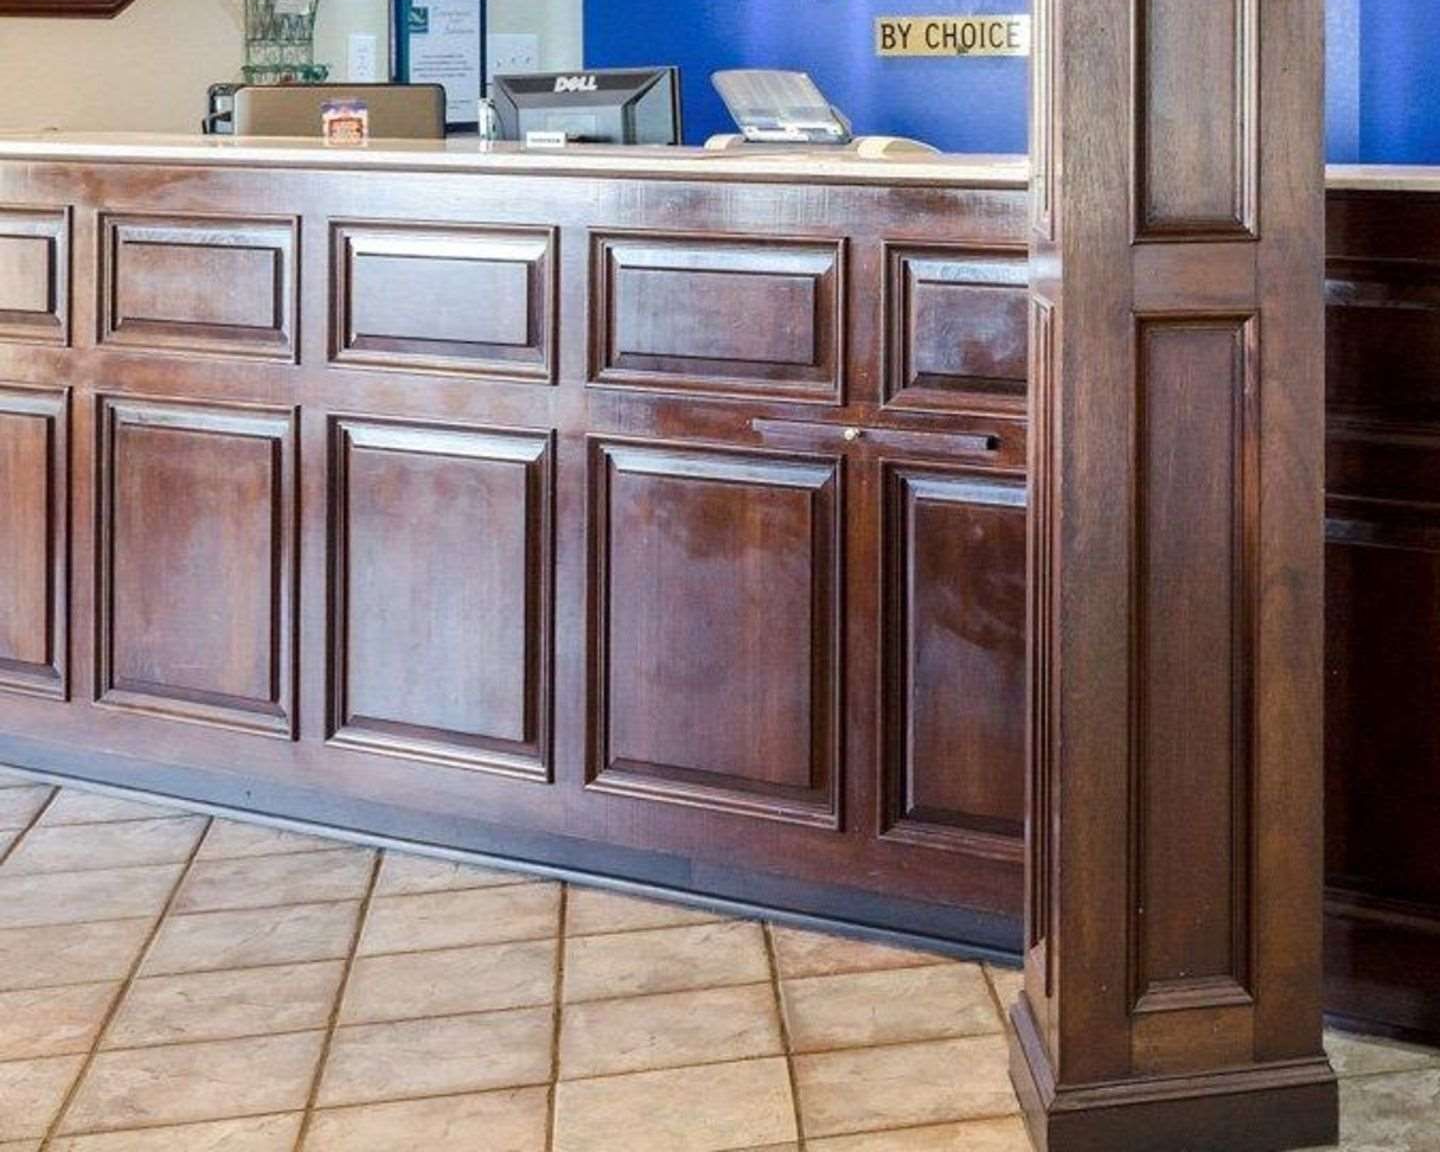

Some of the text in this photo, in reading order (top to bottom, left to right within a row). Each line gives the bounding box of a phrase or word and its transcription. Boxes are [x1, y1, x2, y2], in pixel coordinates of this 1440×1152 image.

[881, 22, 1021, 50] BY CHOICE
[553, 75, 598, 92] DELL
